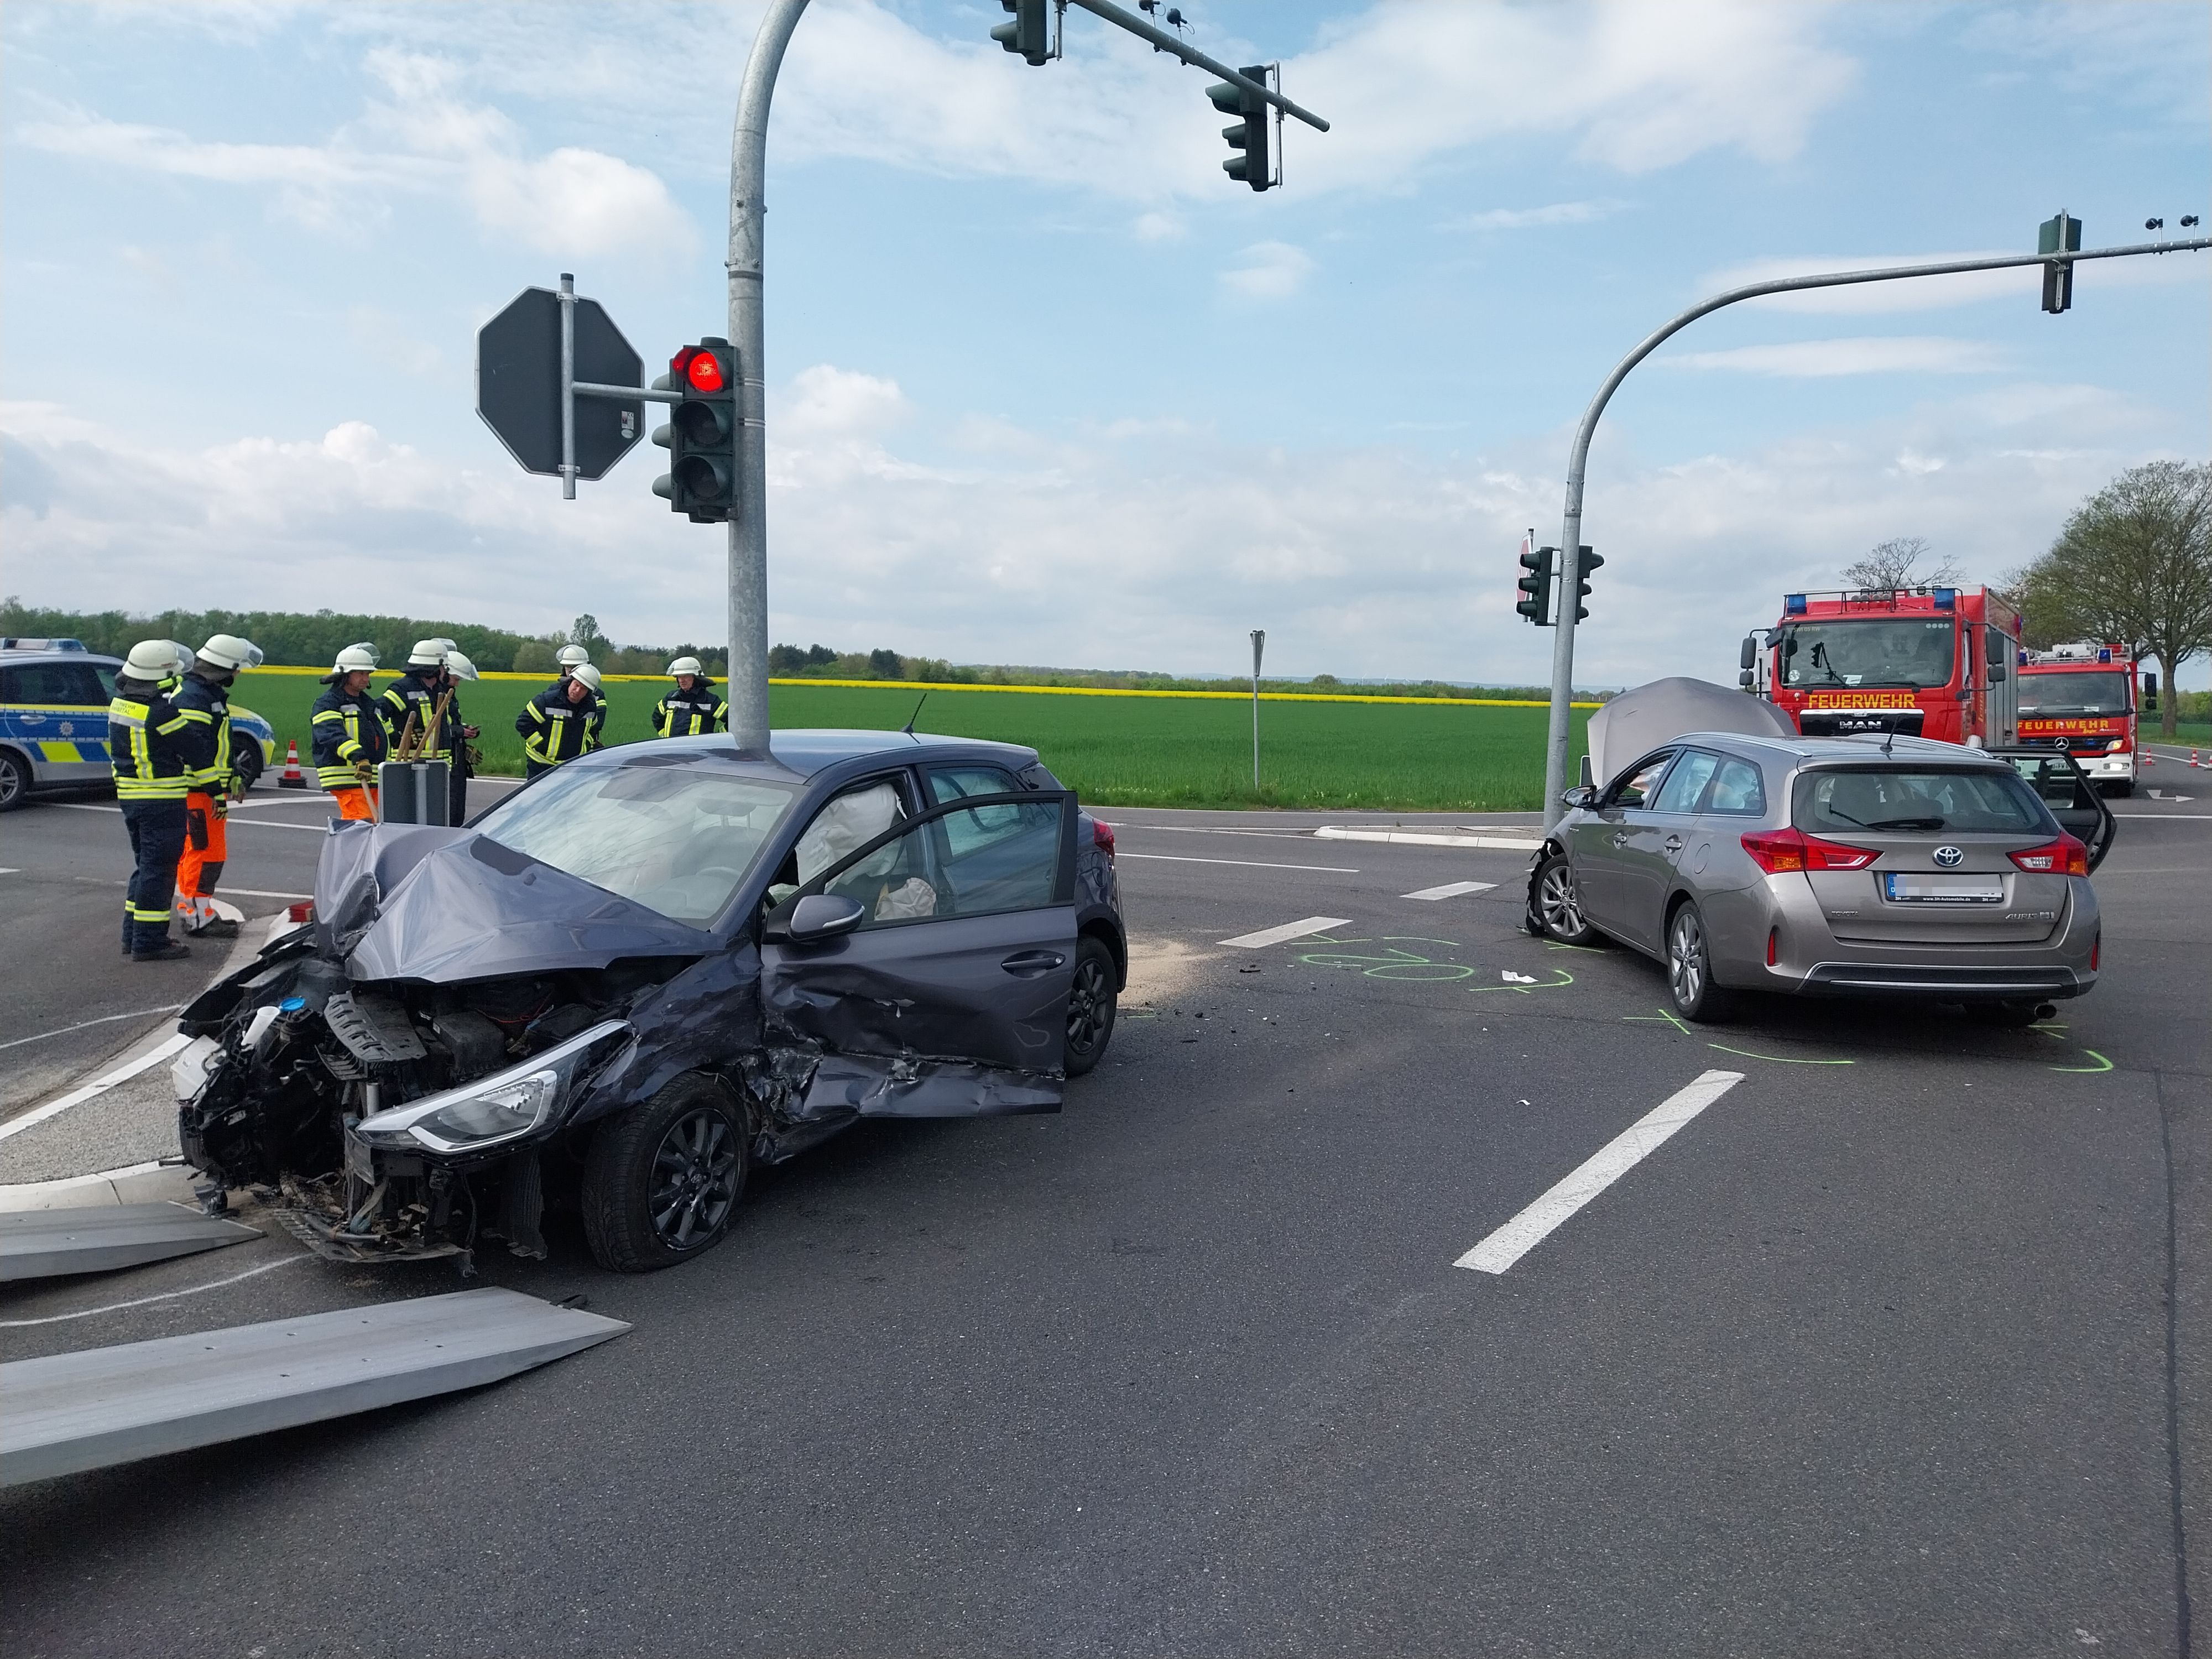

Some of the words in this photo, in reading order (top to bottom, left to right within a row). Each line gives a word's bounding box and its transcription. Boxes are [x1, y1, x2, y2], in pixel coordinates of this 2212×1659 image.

[1808, 693, 1916, 708] FEUERWEHR
[1839, 721, 1882, 729] MAN
[2017, 719, 2109, 729] FEUERWEHR
